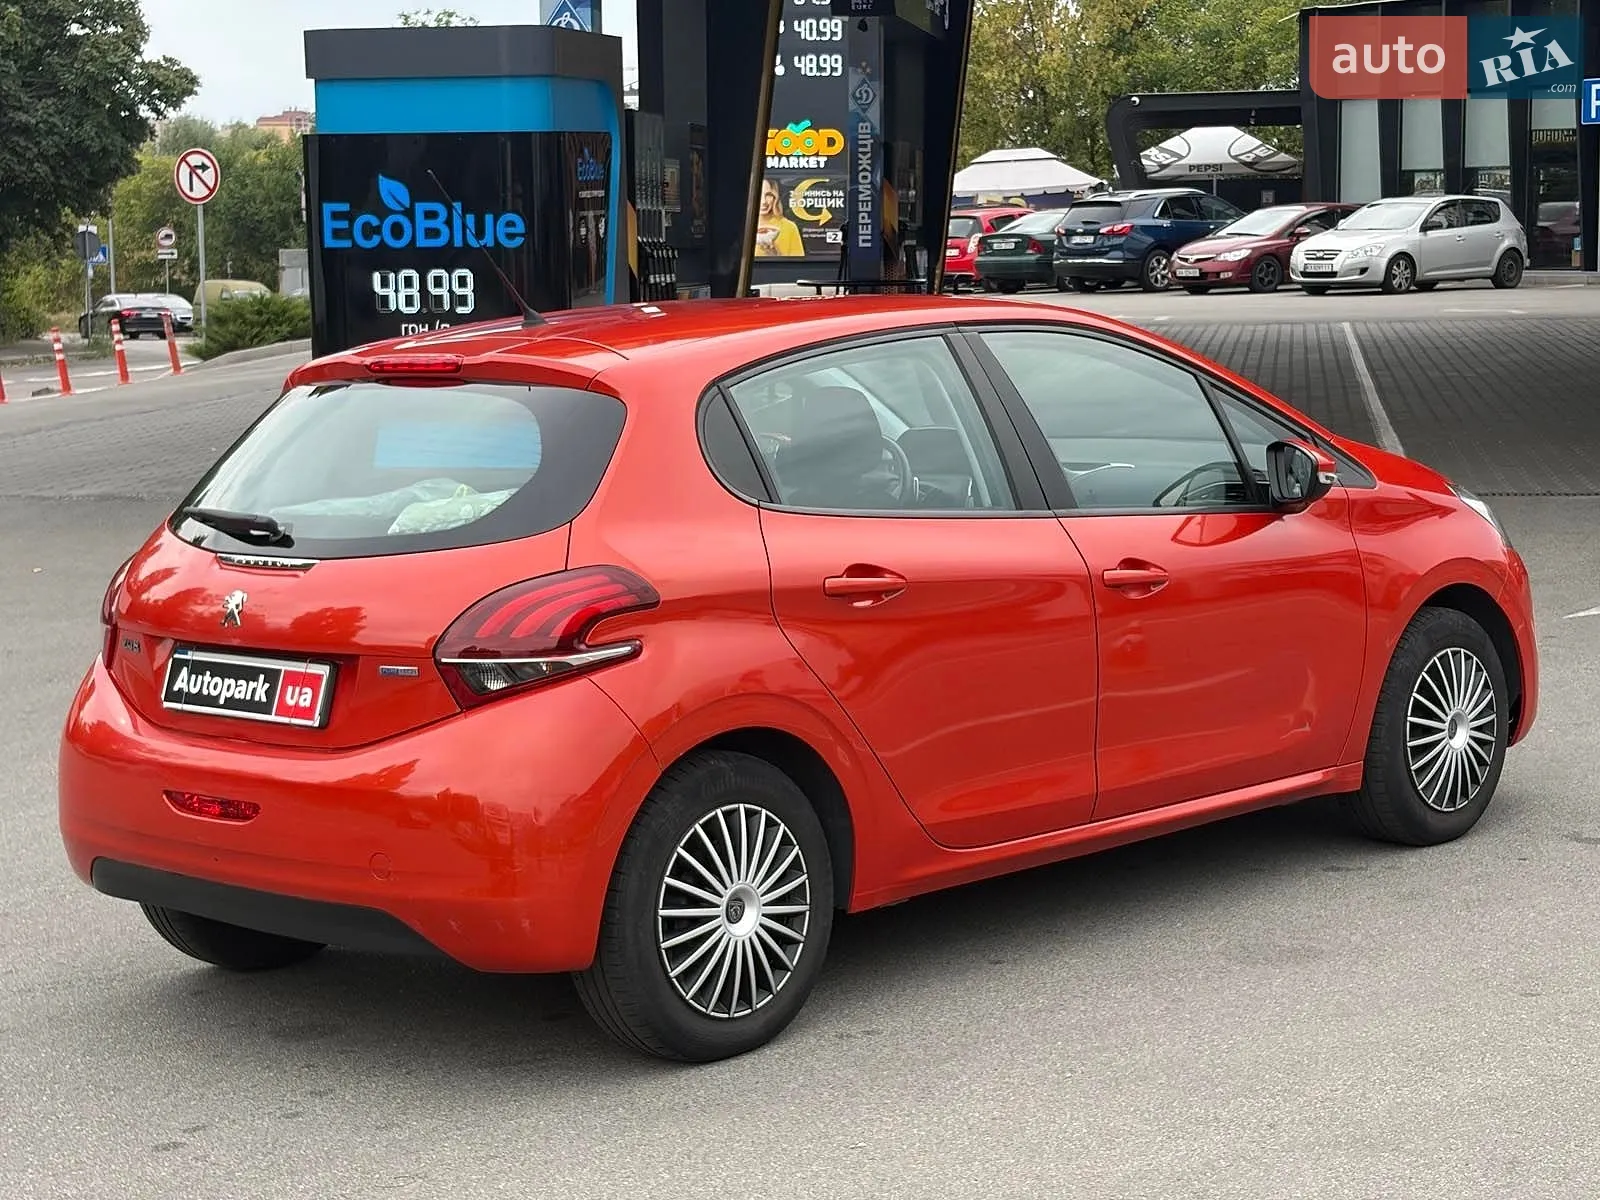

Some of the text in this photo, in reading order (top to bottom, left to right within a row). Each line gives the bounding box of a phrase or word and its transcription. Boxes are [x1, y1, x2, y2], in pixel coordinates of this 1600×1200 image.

[793, 18, 843, 41] 40.99
[793, 54, 843, 77] 48.99
[766, 156, 828, 169] MARKET
[1188, 163, 1223, 173] PEPSI
[858, 122, 873, 248] ПЕРЕМОЖЦІВ
[789, 198, 845, 209] БОРЩИК
[322, 202, 527, 248] EcoBlue
[372, 268, 475, 314] 48.99
[173, 666, 313, 708] Autopark ua
